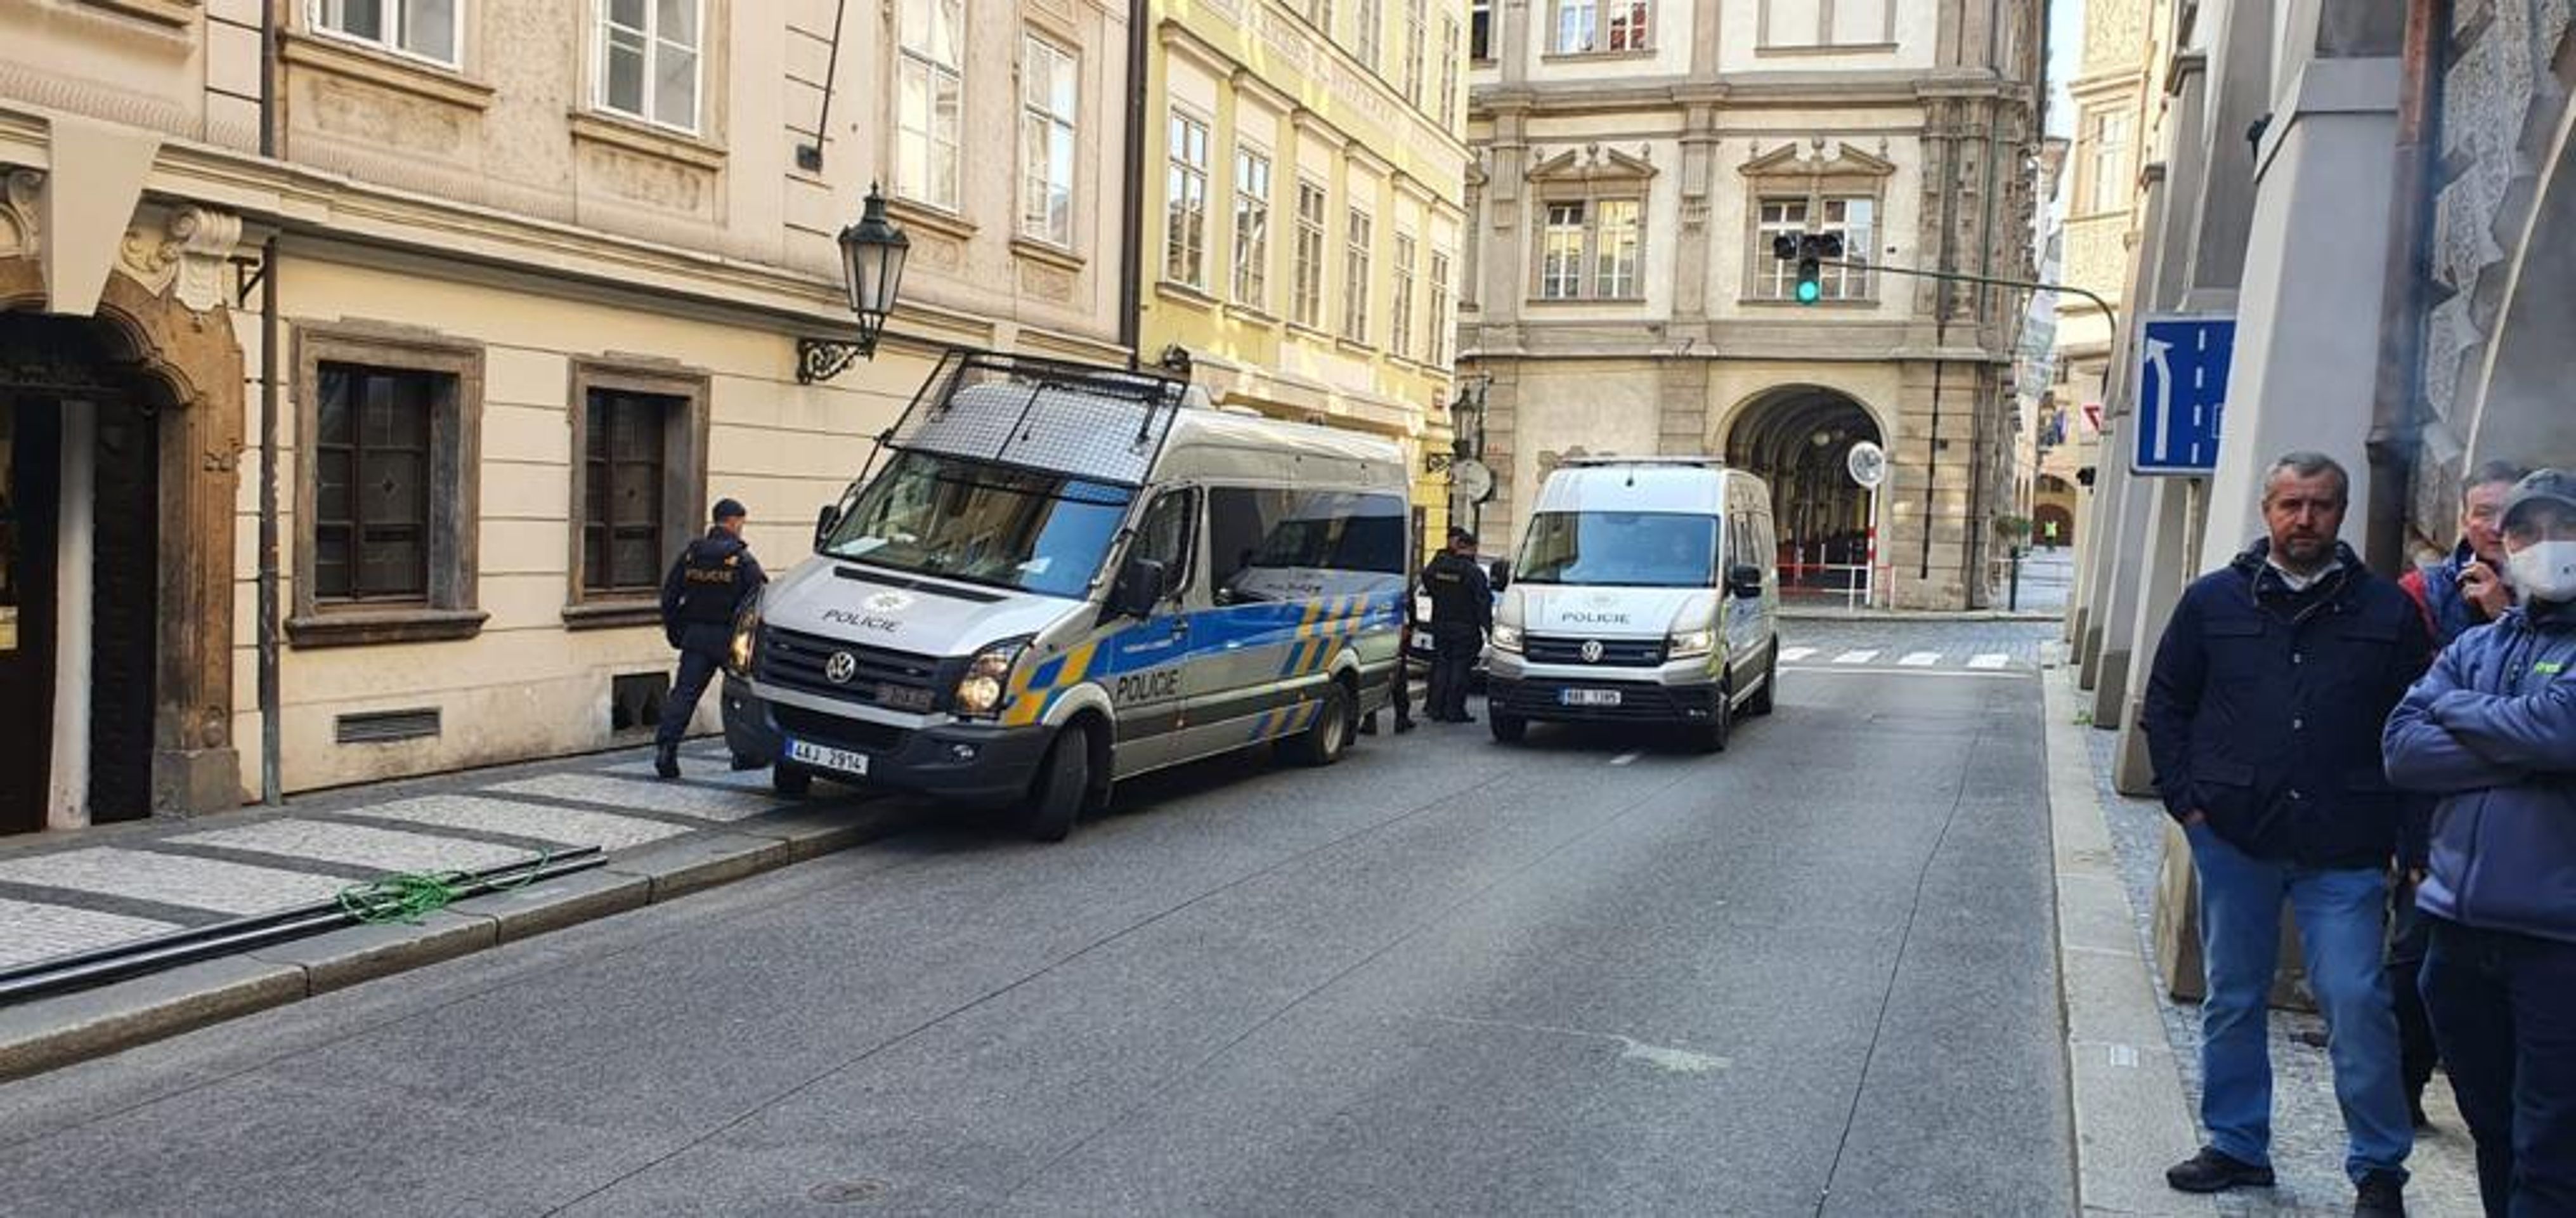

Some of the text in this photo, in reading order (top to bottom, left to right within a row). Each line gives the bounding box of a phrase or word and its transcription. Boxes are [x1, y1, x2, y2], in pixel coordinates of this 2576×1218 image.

[823, 609, 902, 632] POLICIE
[1562, 612, 1631, 624] POLICIE
[1116, 669, 1179, 703] POLICIE
[829, 749, 862, 769] 2914
